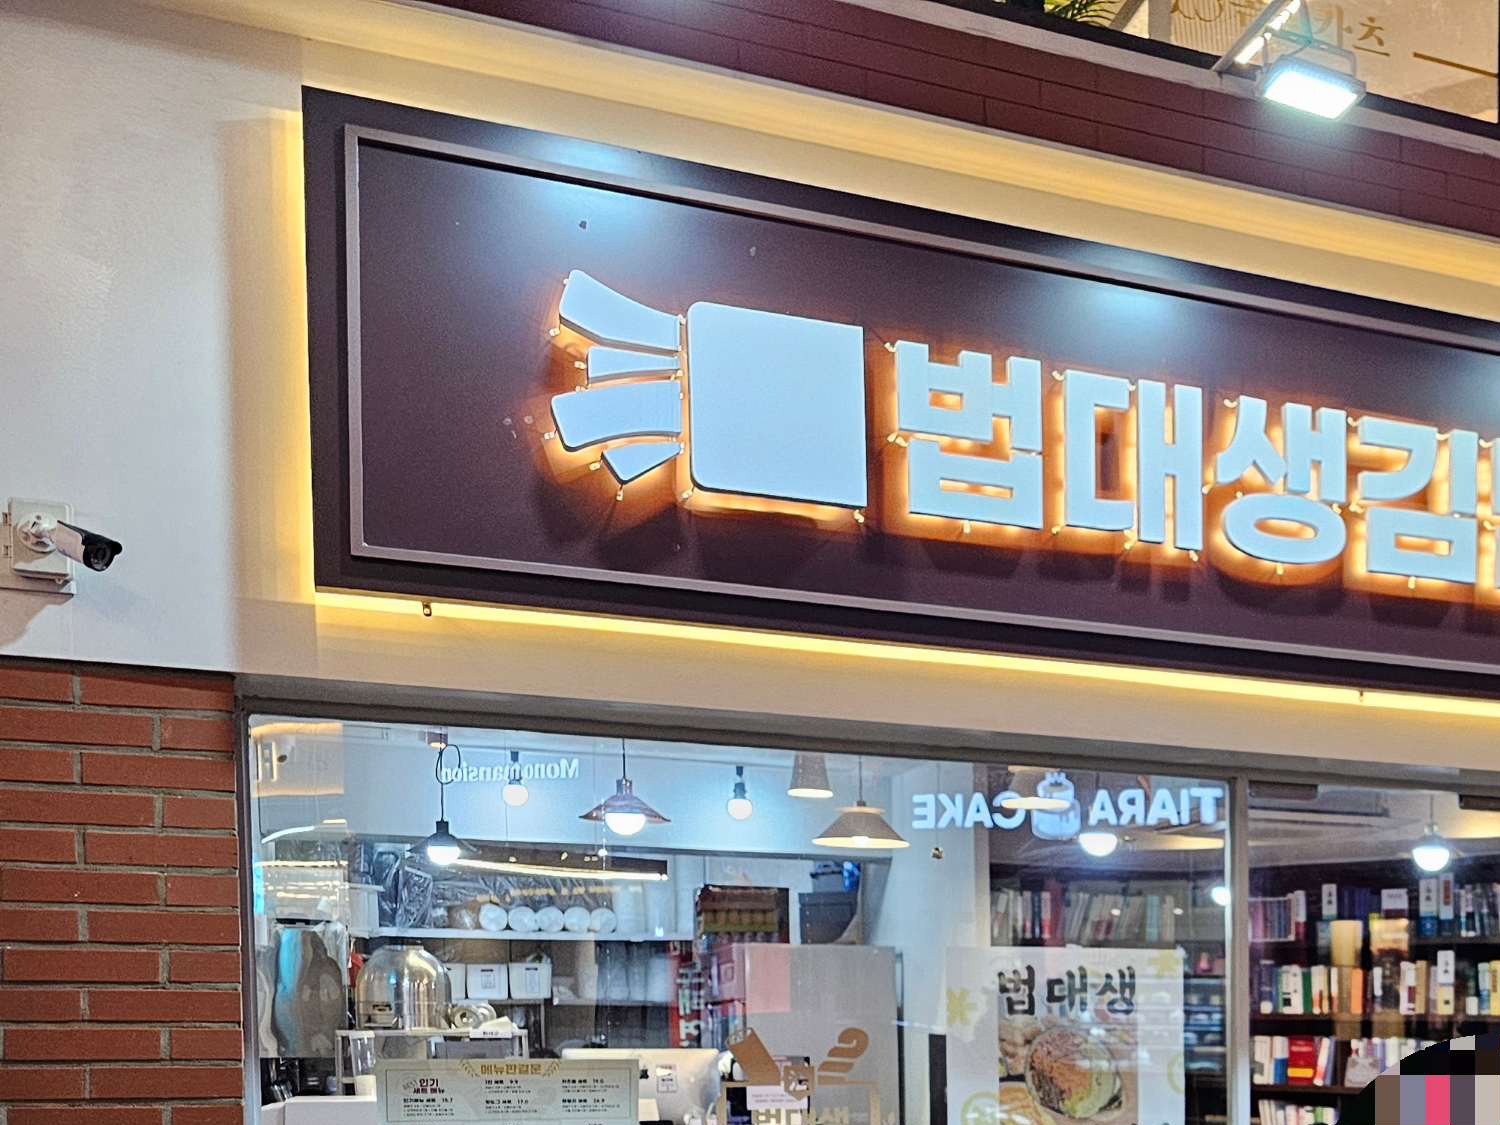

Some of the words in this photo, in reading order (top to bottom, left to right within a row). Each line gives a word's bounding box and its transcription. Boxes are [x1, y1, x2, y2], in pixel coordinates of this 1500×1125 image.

[998, 964, 1136, 1017] 법대생
[480, 1063, 542, 1076] 메뉴판결문
[419, 1078, 439, 1088] 인기
